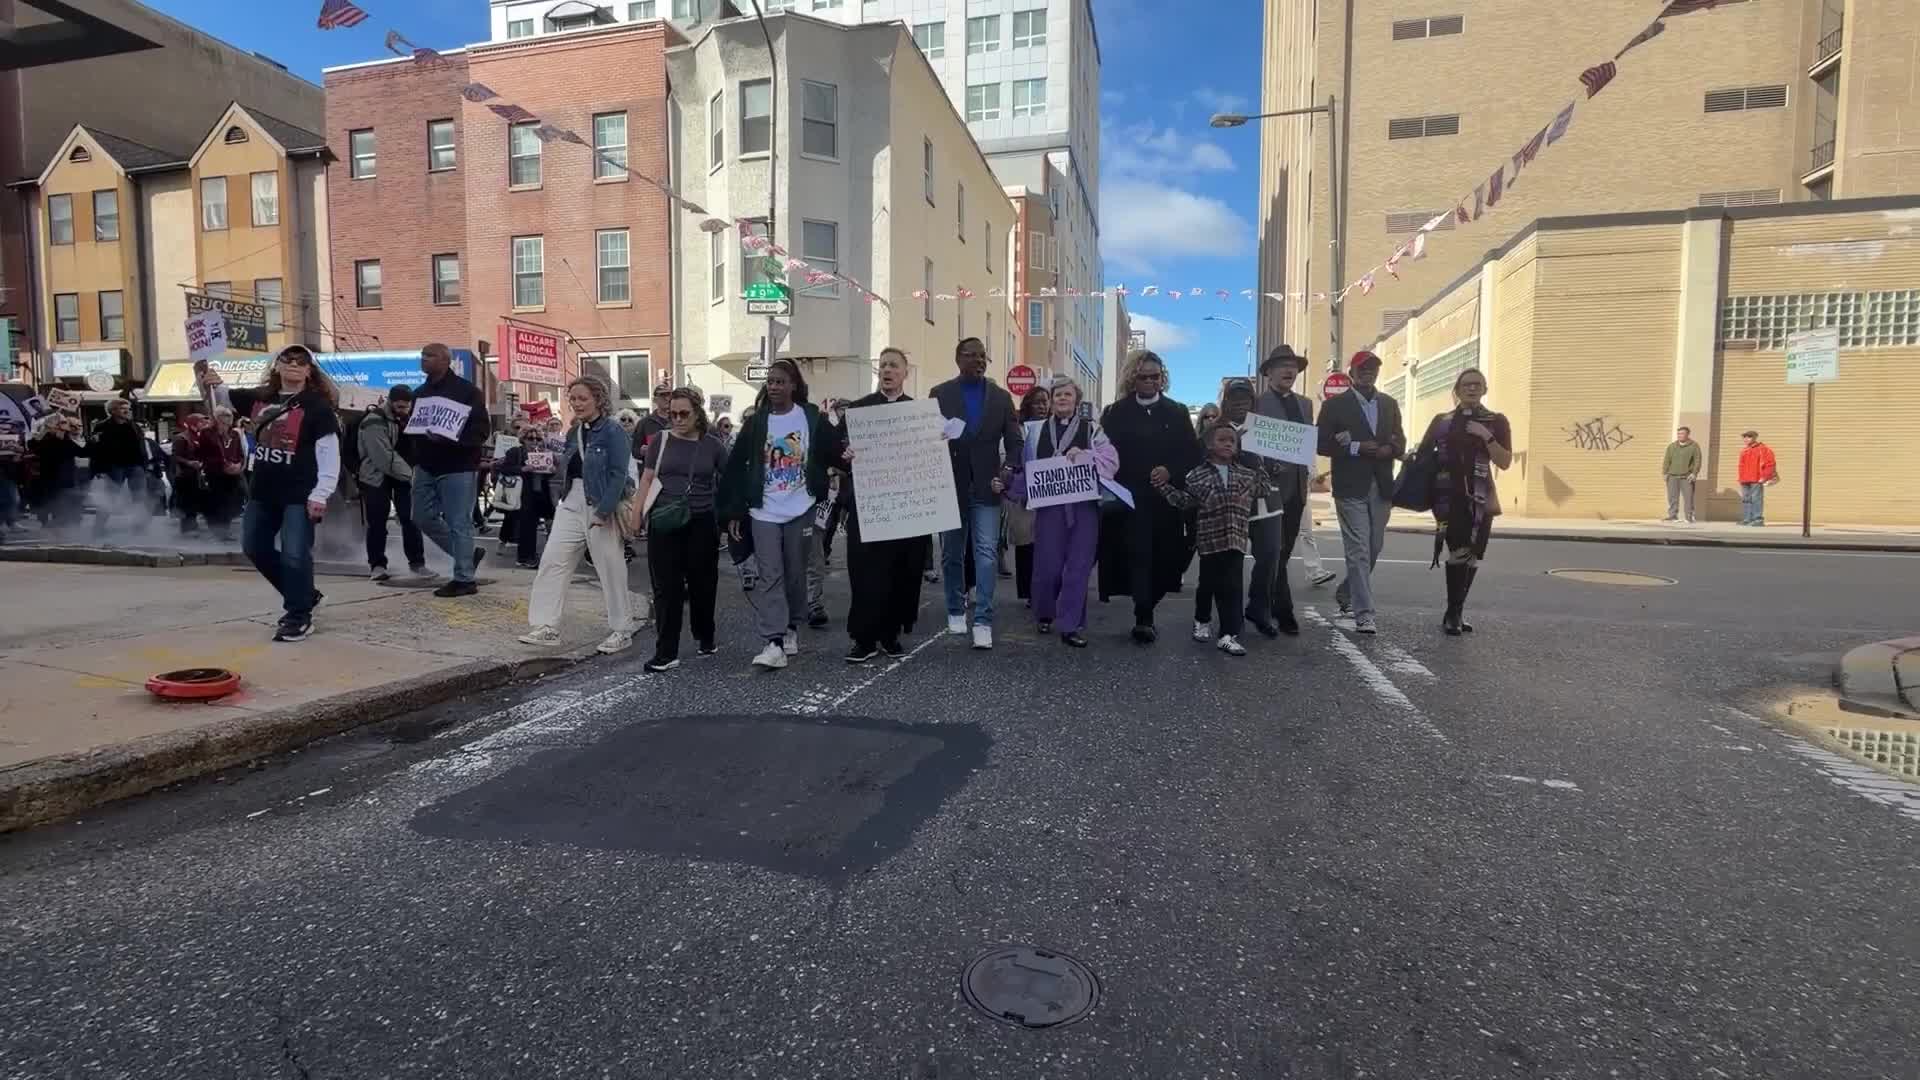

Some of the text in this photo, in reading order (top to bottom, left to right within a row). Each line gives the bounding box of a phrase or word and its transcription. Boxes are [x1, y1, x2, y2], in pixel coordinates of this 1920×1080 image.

[190, 296, 264, 318] SUCCESS
[518, 333, 555, 347] ALLCARE
[518, 342, 555, 357] MEDICAL
[516, 353, 557, 368] EQUIPMENT
[436, 405, 460, 422] WITH
[1254, 416, 1306, 433] Love your
[1254, 428, 1304, 445] neighbor
[1033, 463, 1091, 485] STAND WITH
[1028, 479, 1094, 500] IMMIGRANTS.
